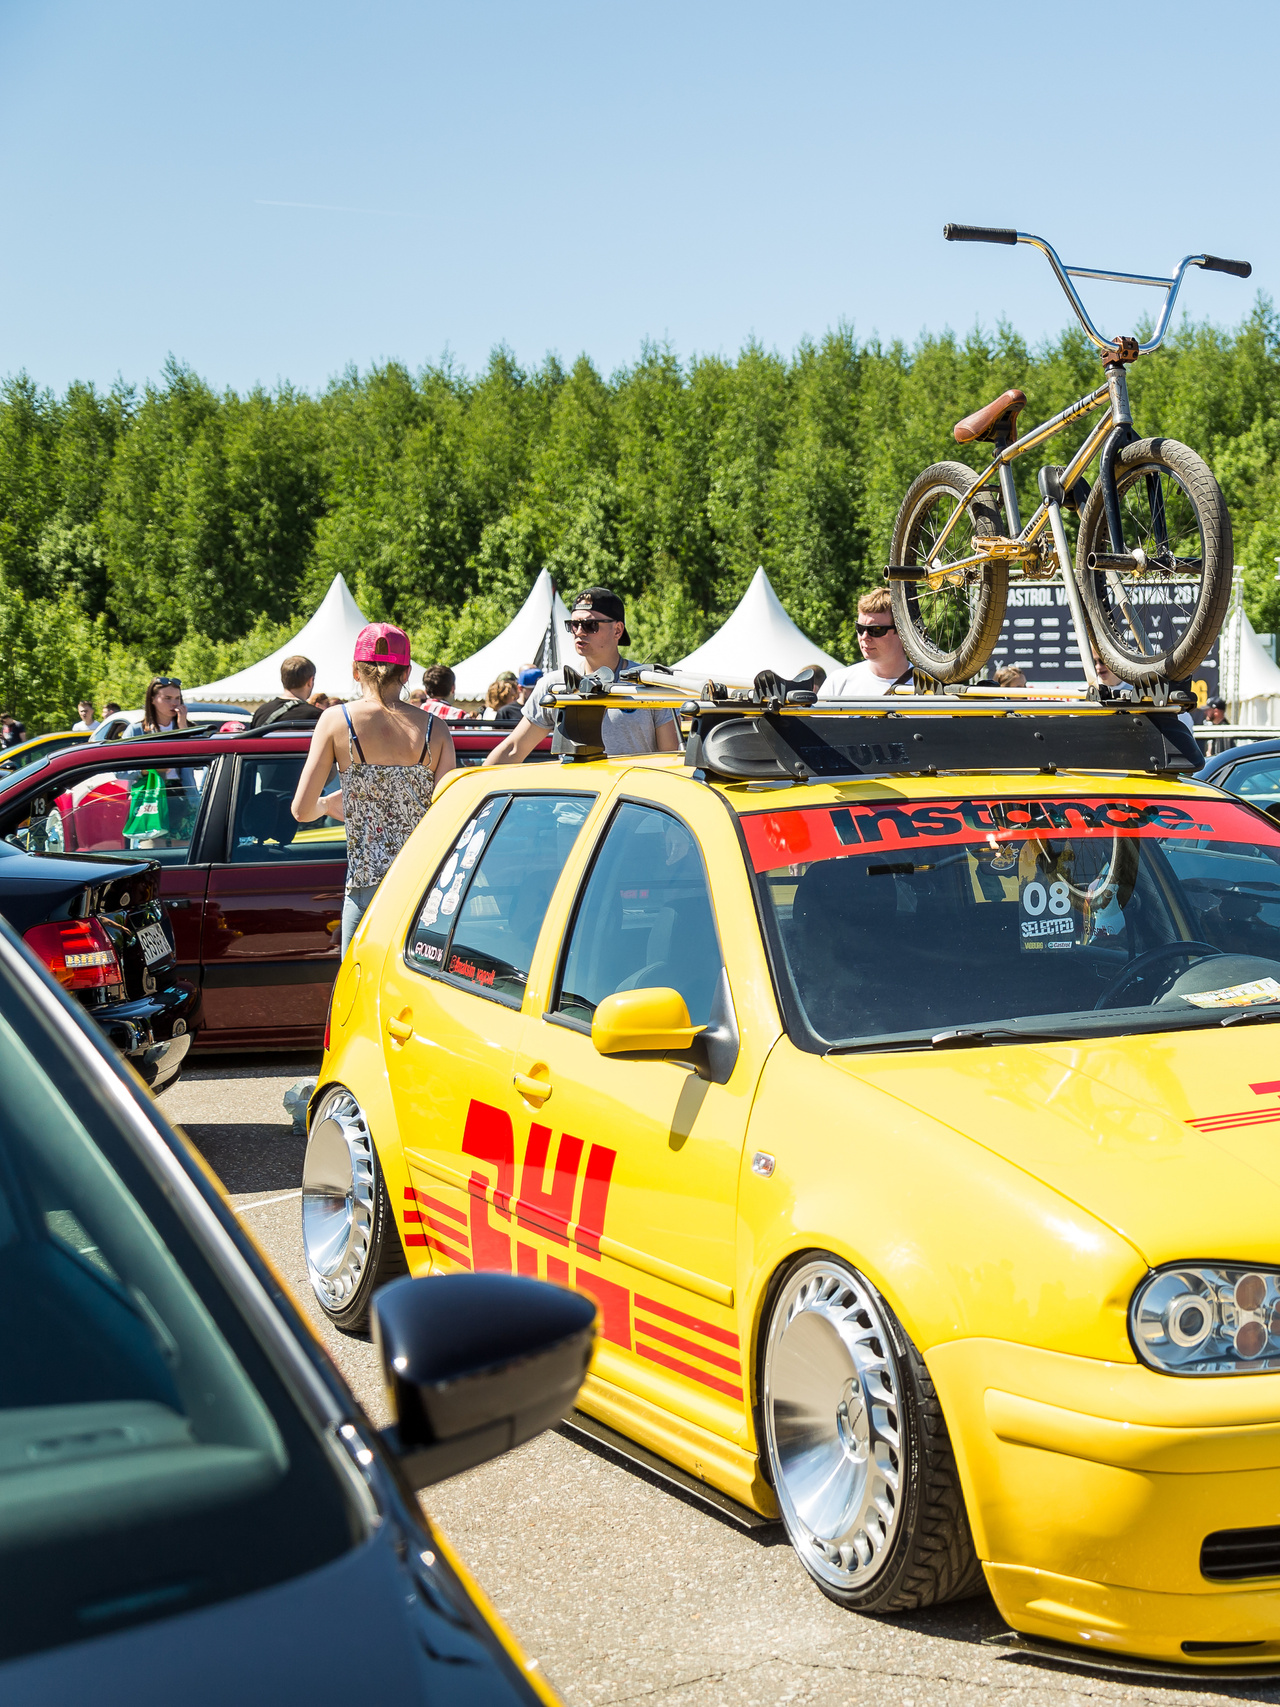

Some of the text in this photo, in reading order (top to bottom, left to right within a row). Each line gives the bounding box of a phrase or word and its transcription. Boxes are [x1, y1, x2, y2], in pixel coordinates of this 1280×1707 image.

[1007, 587, 1055, 607] ASTROL
[1173, 585, 1200, 605] 201
[34, 797, 46, 815] 13
[1022, 881, 1072, 916] 08
[1020, 917, 1075, 938] SELECTED
[461, 1098, 632, 1352] DHL
